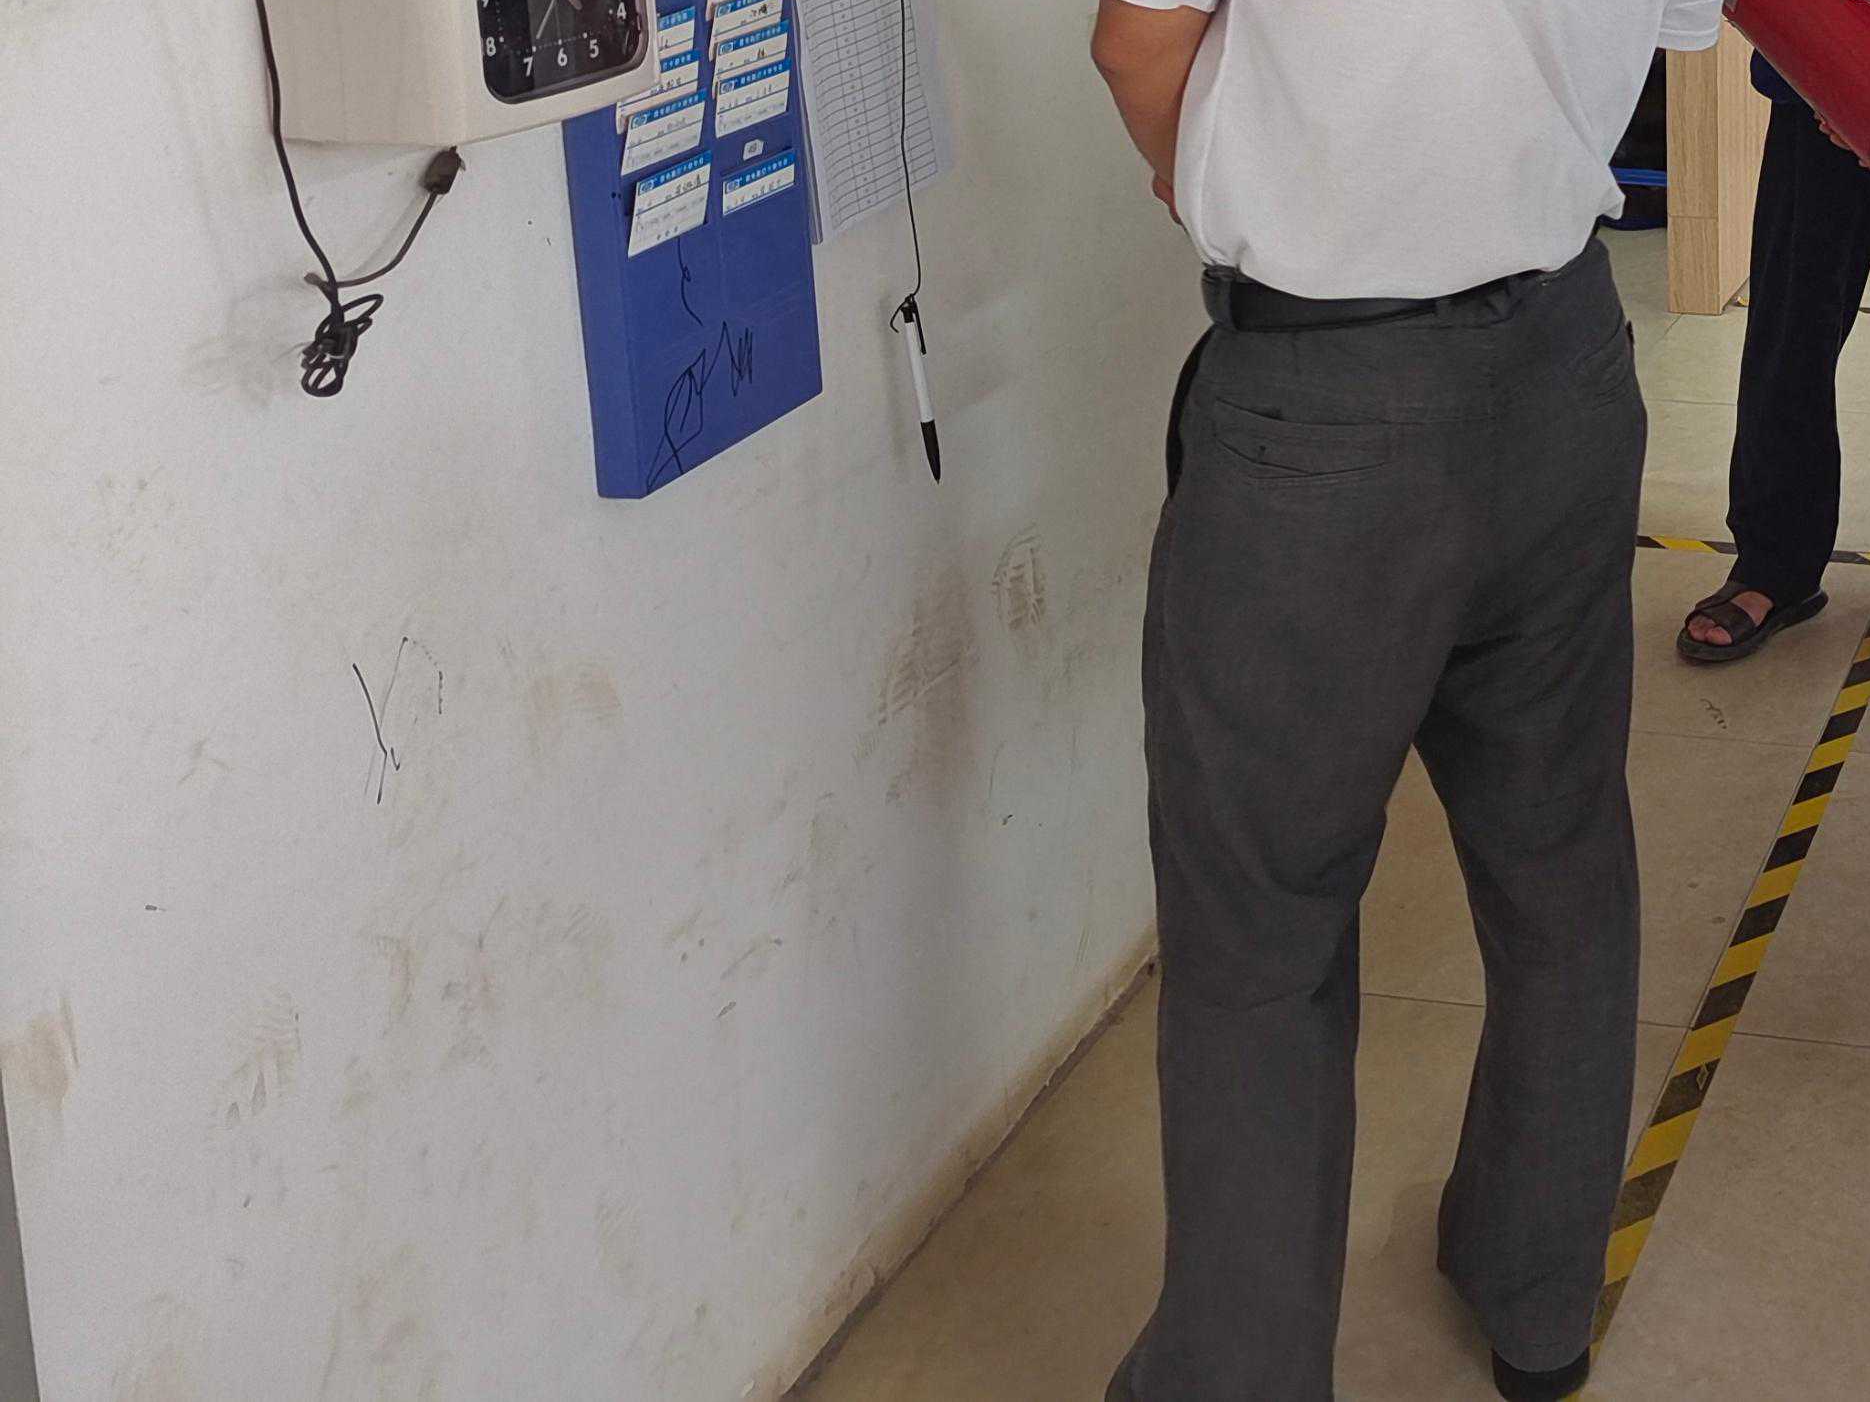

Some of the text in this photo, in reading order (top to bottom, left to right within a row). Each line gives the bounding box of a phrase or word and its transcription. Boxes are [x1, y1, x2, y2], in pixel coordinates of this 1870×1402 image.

[616, 1, 627, 20] 4
[485, 36, 496, 57] 8
[588, 39, 600, 59] 5
[523, 57, 534, 77] 7
[557, 47, 568, 67] 6
